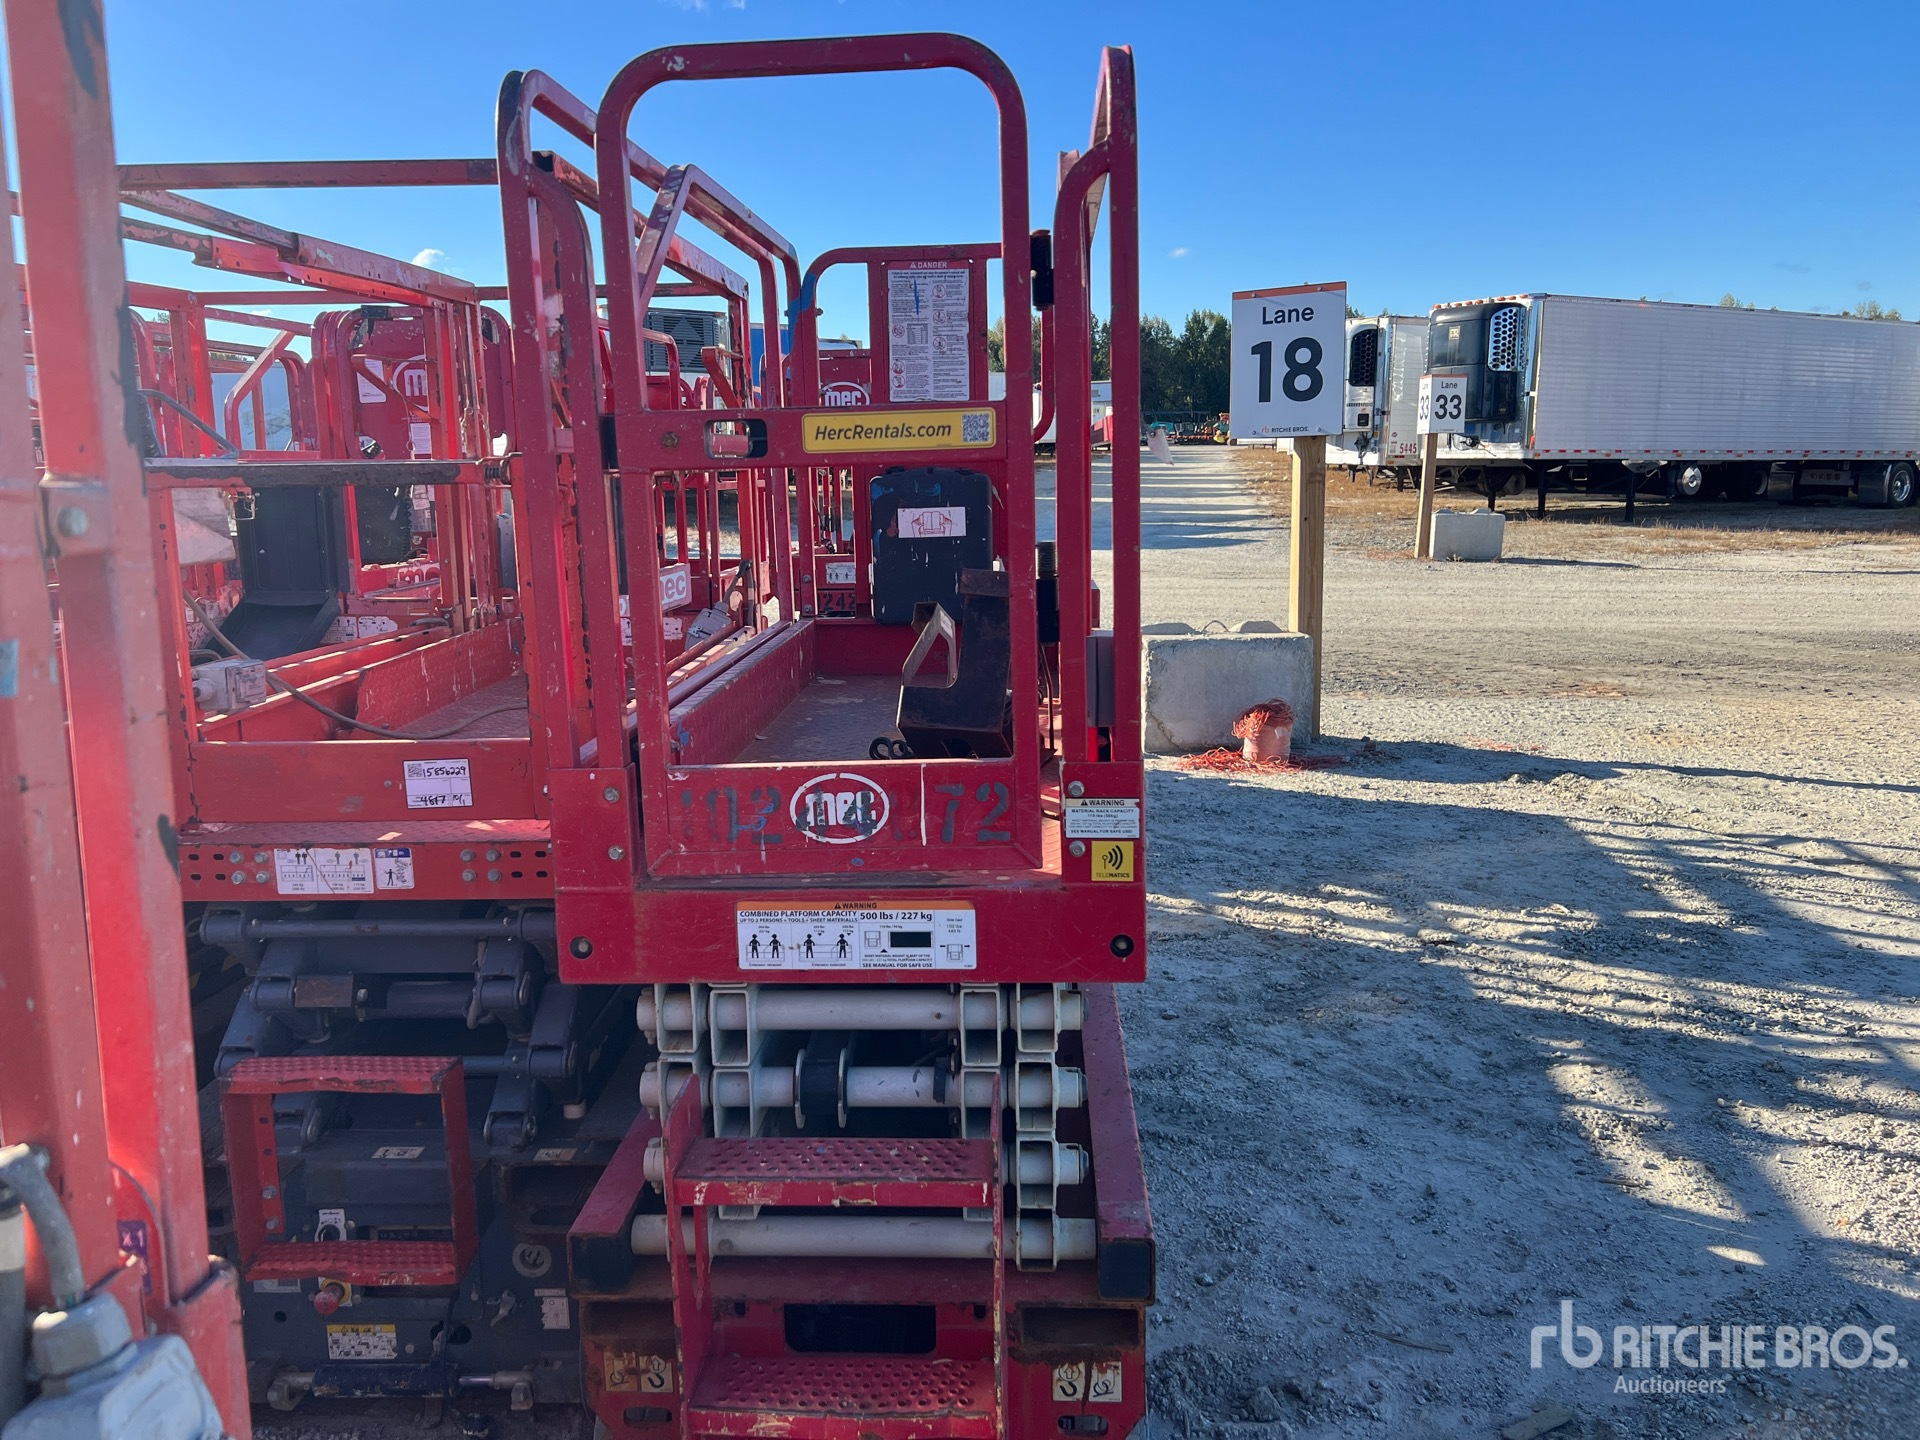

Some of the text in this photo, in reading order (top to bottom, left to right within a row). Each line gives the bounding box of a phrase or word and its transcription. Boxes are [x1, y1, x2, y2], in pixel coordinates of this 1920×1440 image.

[1262, 306, 1314, 325] Lane
[1250, 336, 1324, 402] 18
[1441, 381, 1458, 389] Lane
[1420, 395, 1430, 420] 33
[1434, 394, 1462, 420] 33
[815, 424, 952, 440] HercRentals.com
[1400, 443, 1417, 454] 5445
[806, 792, 876, 826] mec
[920, 912, 932, 921] kg
